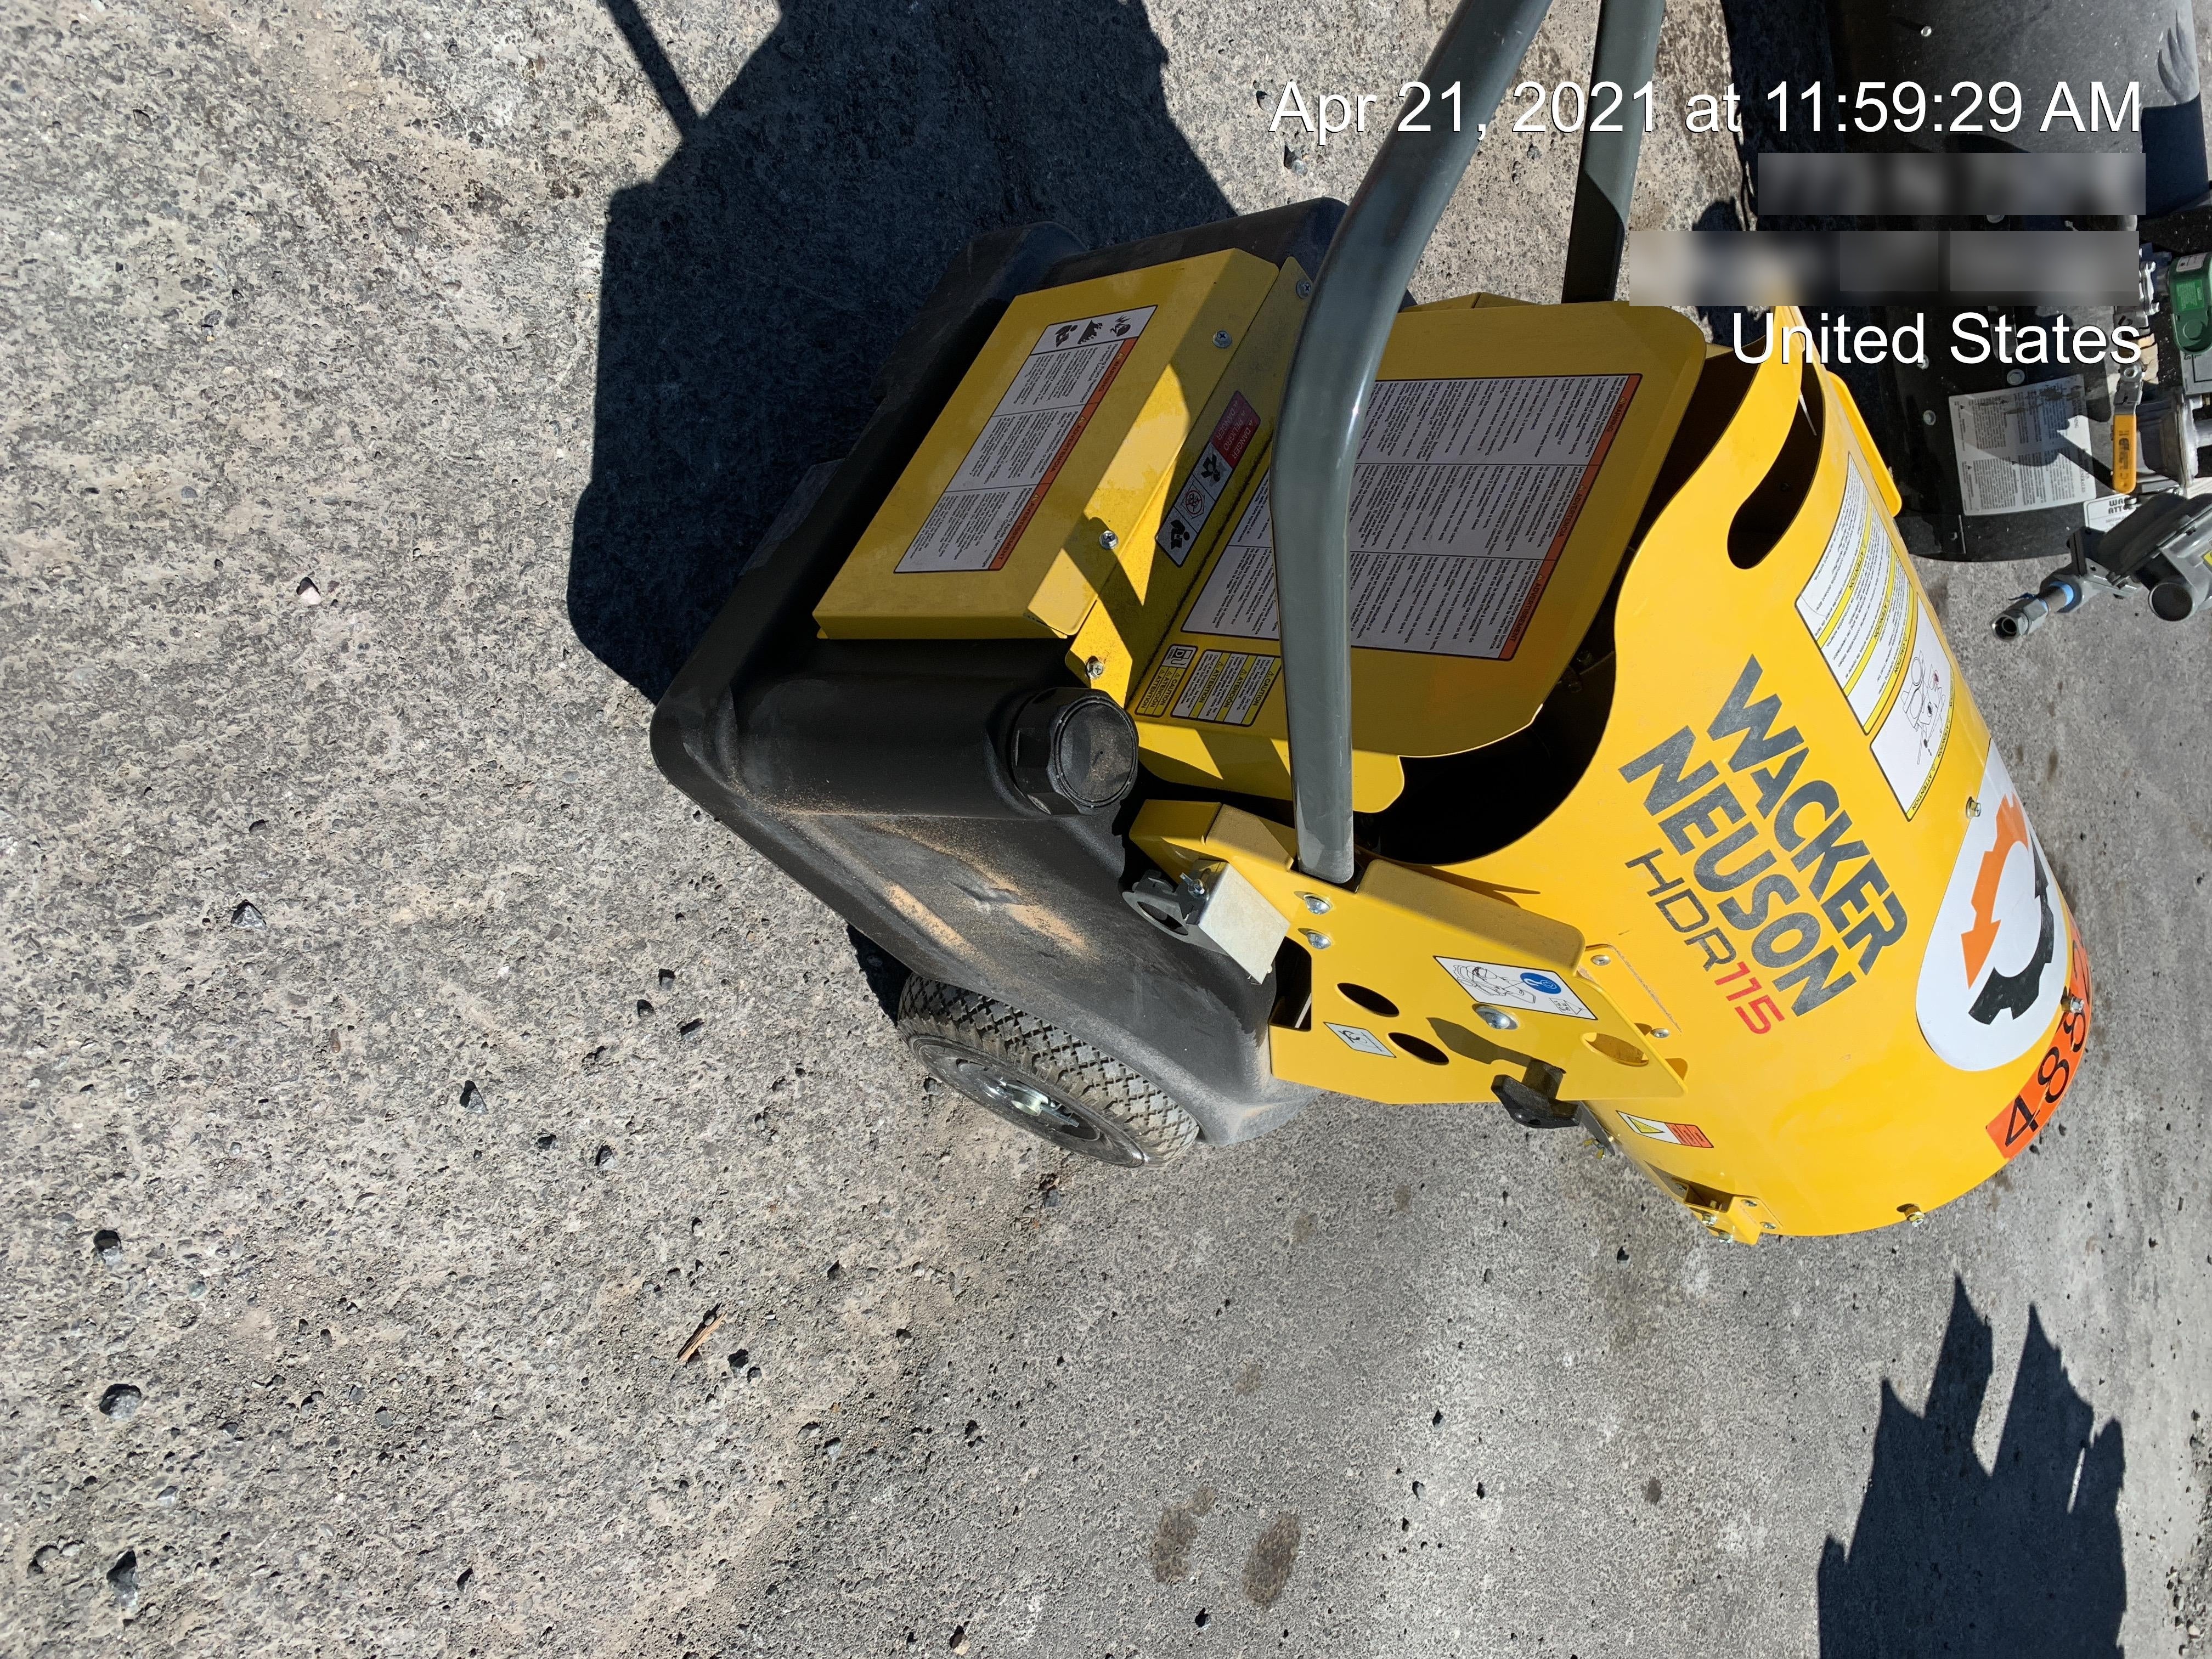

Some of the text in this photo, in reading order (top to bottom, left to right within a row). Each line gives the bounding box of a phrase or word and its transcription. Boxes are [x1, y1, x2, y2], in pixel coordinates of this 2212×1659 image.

[1216, 407, 1235, 441] DANGER
[1222, 417, 1243, 452] PELIGRO
[1231, 426, 1251, 459] DANGER
[1558, 493, 1583, 537] ADVERTENCIA
[1848, 551, 1864, 590] ATTENTION
[1874, 603, 1888, 640] ATENCIÓN
[1894, 644, 1905, 674] CAUTION
[1141, 675, 1162, 708] ATTENTION
[1149, 677, 1169, 707] ATENCIÓN
[1159, 679, 1178, 706] CAUTION
[1198, 669, 1220, 703] ATTENTION
[1223, 676, 1244, 708] ATENCIÓN
[1252, 678, 1271, 706] CAUTION
[1912, 774, 1932, 811] ATTENTION
[1707, 654, 1908, 975] WACKER
[1618, 725, 1857, 1017] NEUSON
[1624, 847, 1785, 1035] HDR115
